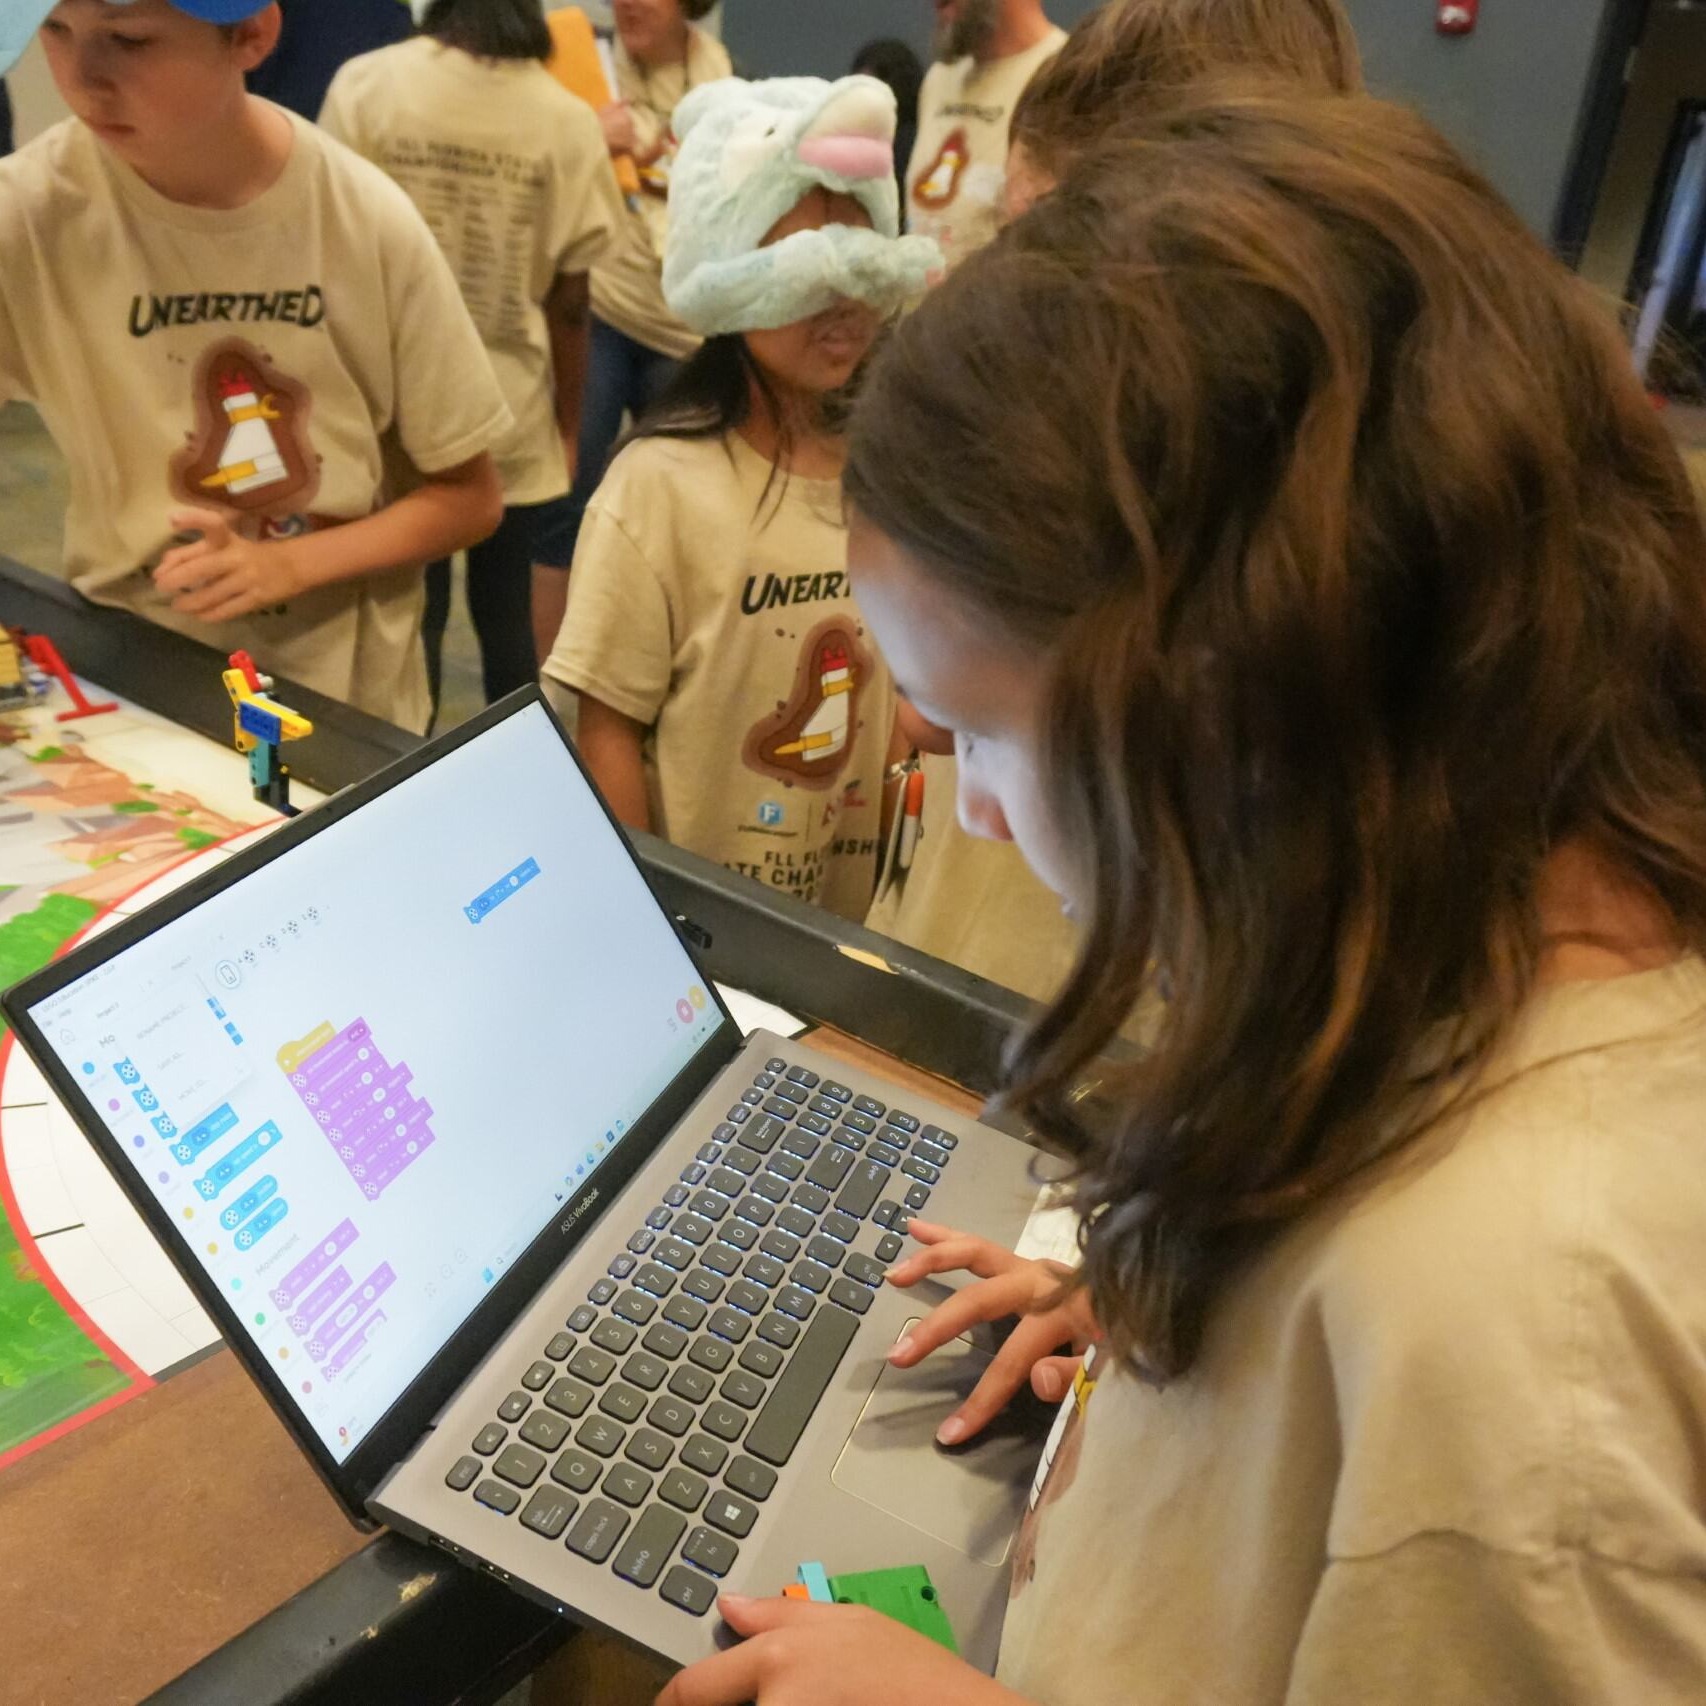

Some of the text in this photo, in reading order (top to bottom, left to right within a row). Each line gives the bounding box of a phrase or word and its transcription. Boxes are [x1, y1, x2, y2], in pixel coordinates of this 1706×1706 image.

[129, 284, 326, 338] UNEARTHED
[764, 851, 795, 866] FLL
[561, 1187, 600, 1235] ASUS VivoBook
